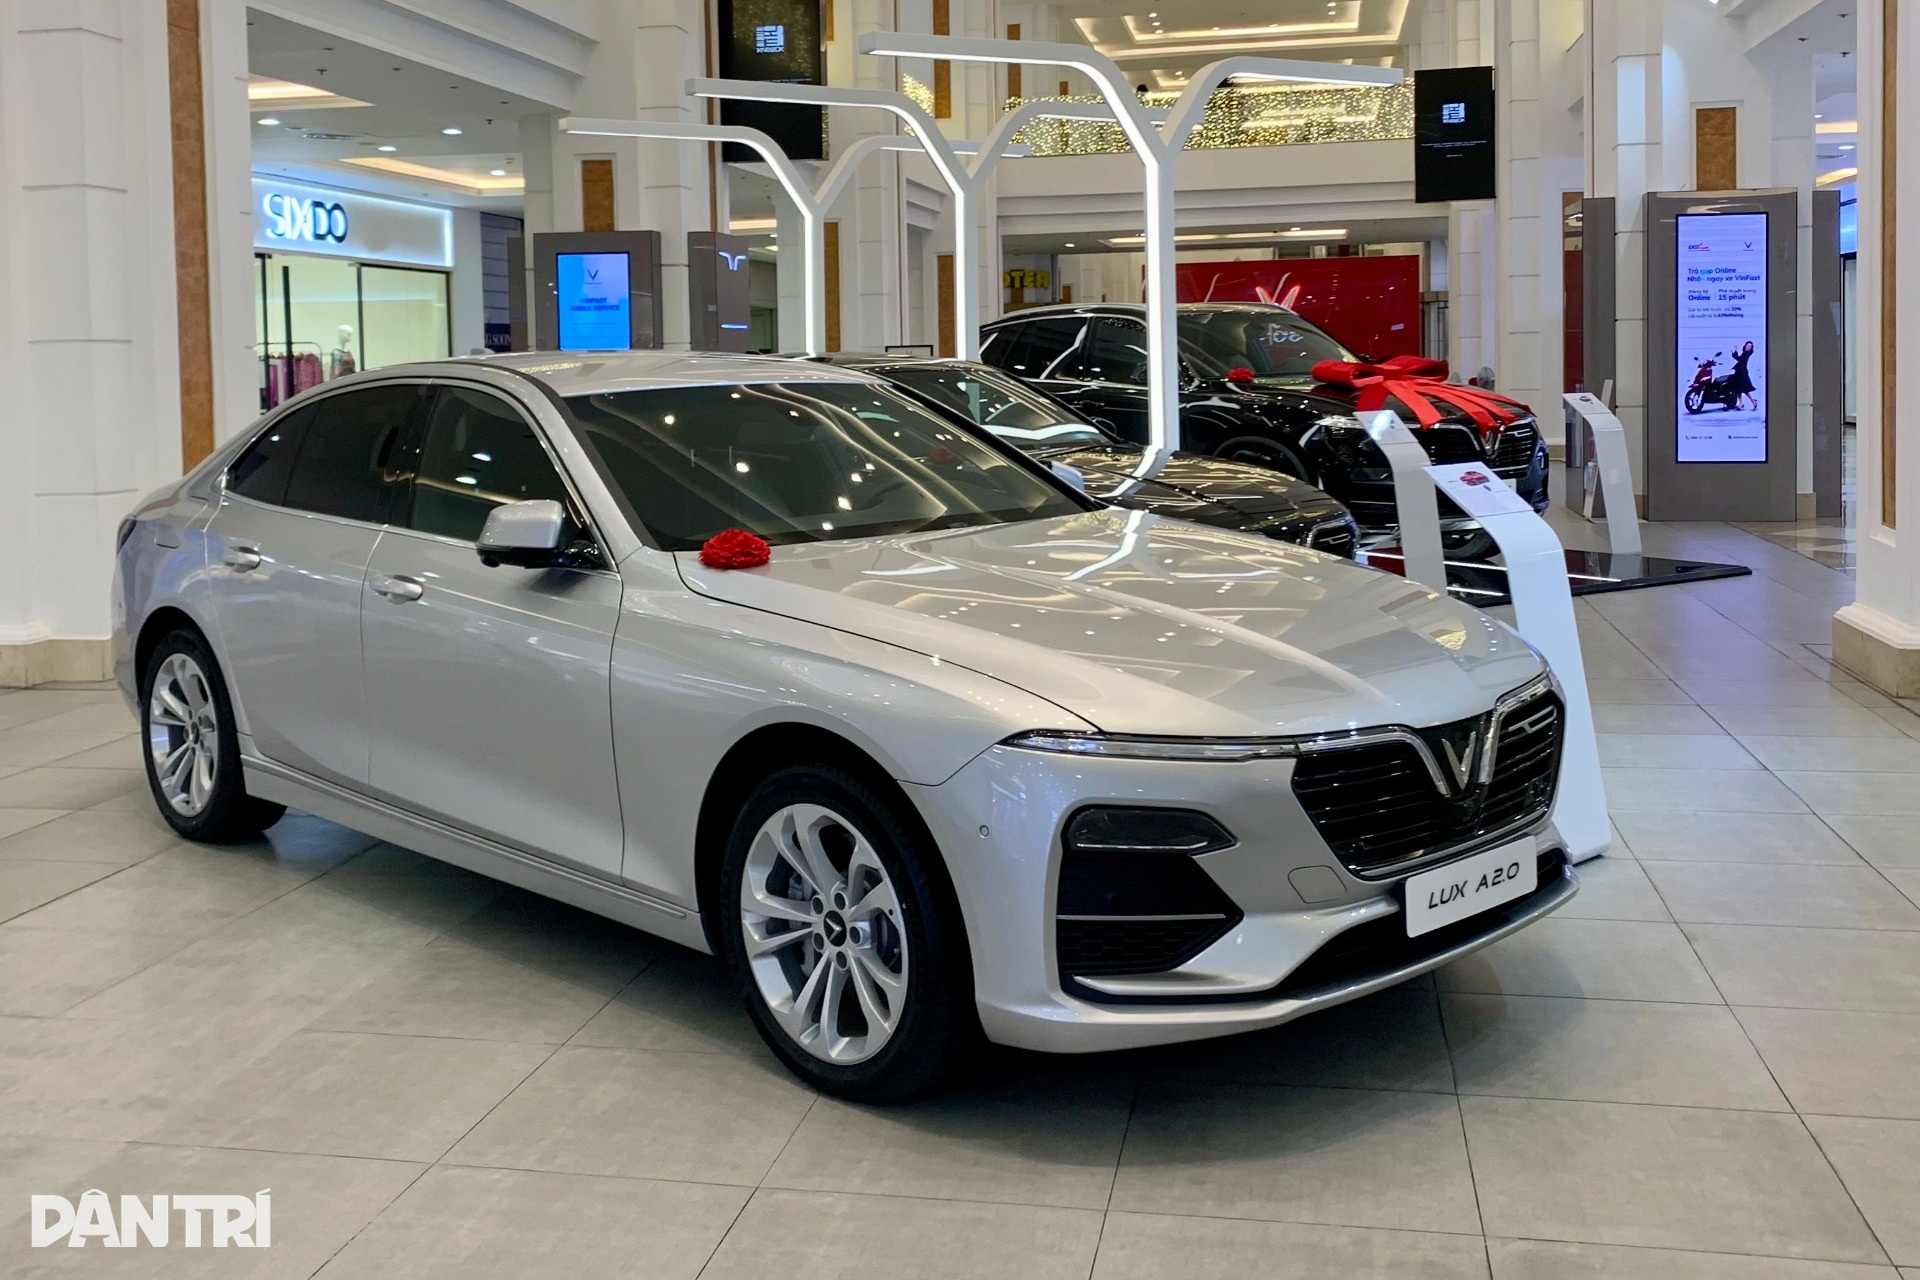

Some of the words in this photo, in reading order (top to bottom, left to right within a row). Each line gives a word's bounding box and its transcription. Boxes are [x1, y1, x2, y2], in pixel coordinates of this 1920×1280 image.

[263, 193, 348, 244] SIXDO
[1428, 880, 1468, 910] LUX
[1475, 862, 1520, 893] A2.0
